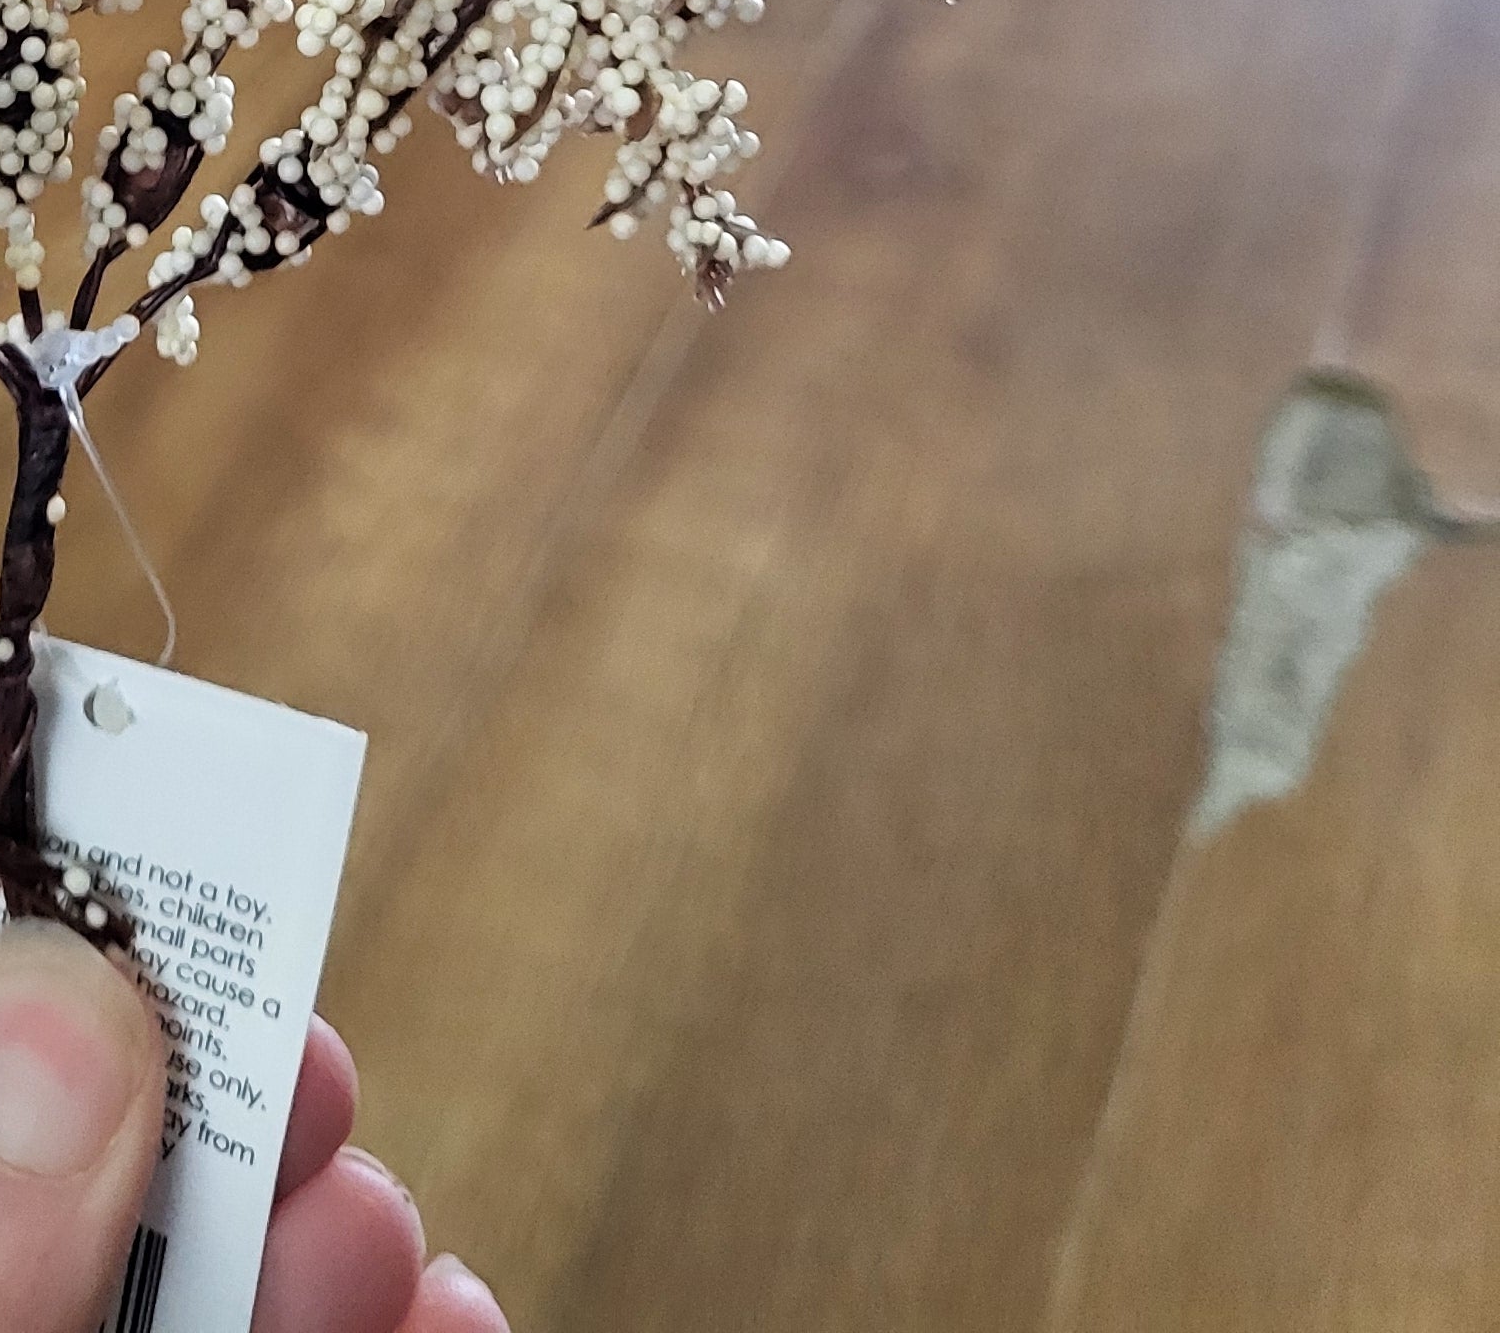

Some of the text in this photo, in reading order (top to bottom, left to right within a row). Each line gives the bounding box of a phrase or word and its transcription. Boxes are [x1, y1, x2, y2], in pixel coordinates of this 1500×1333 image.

[88, 845, 143, 877] and
[148, 863, 194, 895] not
[199, 881, 218, 902] a
[226, 884, 272, 924] toy.
[122, 912, 186, 949] mall
[189, 937, 256, 979] parts
[159, 896, 264, 951] children
[176, 963, 255, 1008] cause
[262, 997, 281, 1020] a
[209, 1069, 266, 1112] only.
[198, 1119, 255, 1166] from
